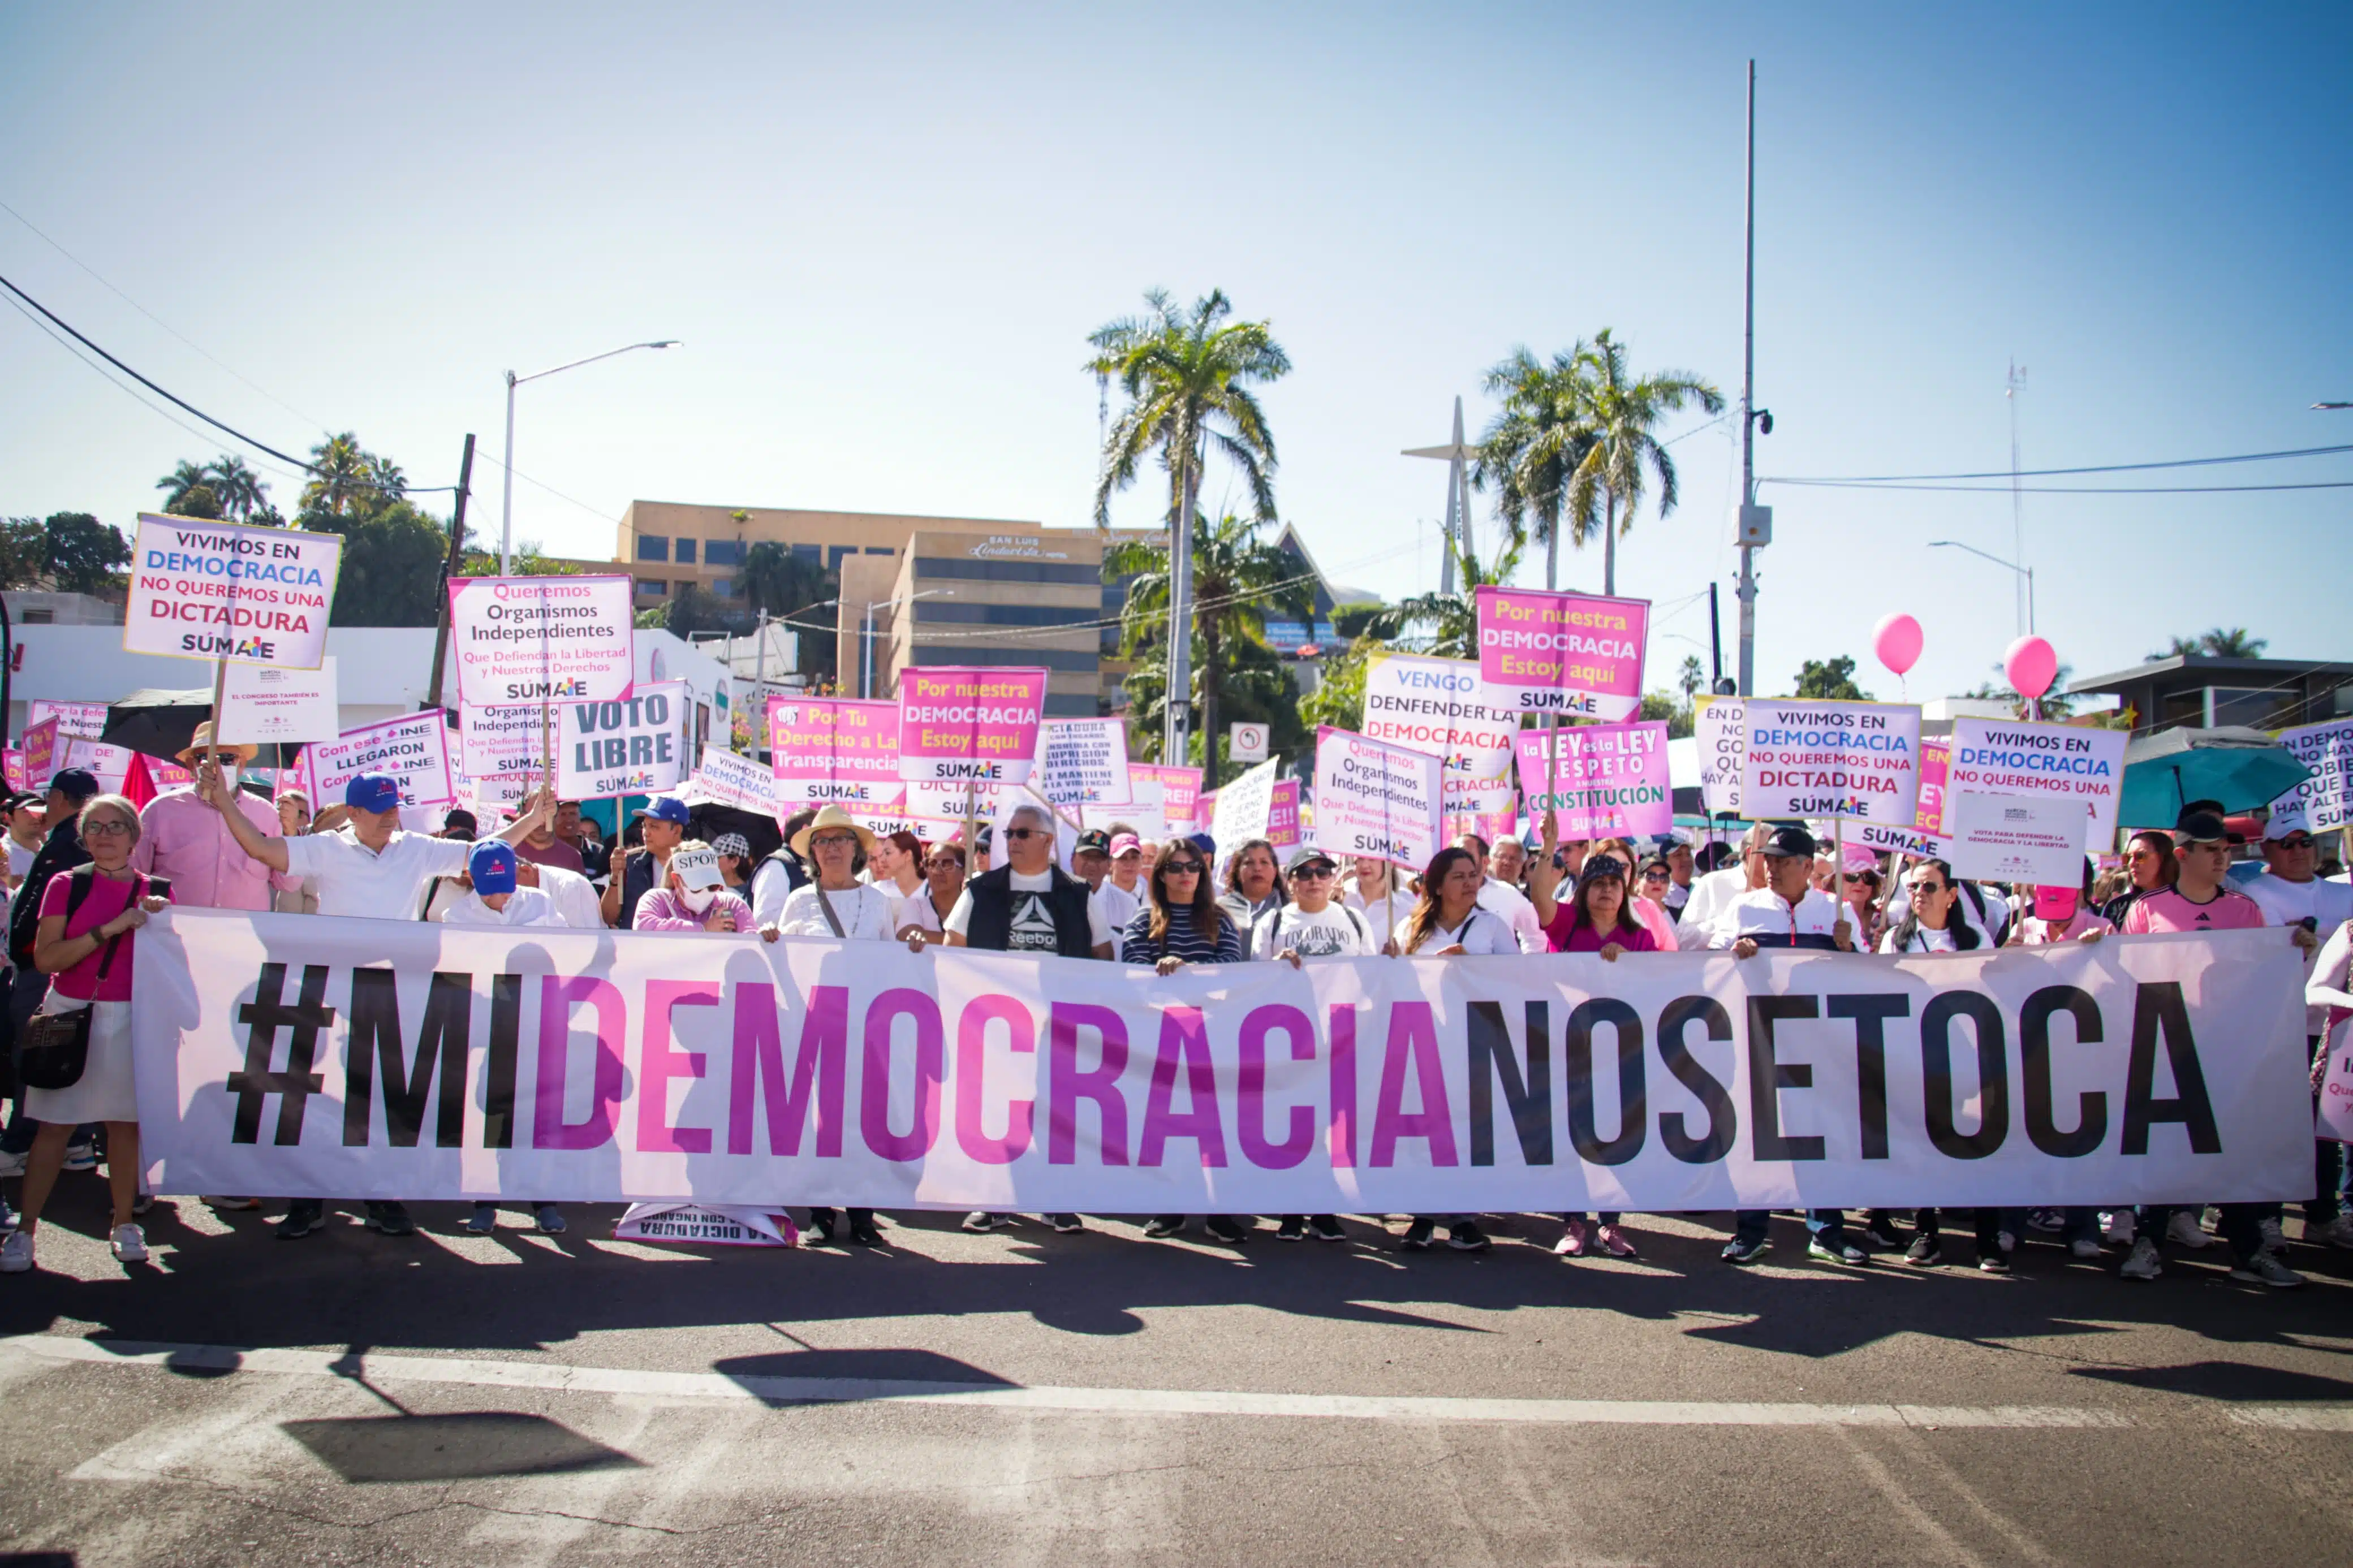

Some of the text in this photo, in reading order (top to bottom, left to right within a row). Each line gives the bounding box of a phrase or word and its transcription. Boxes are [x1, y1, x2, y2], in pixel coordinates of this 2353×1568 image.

[176, 532, 300, 560] VIVIMOS EN
[1015, 538, 1038, 546] LUIS
[147, 550, 323, 586] DEMOCRACIA
[141, 576, 325, 608] NO QUEREMOS UNA
[493, 584, 592, 601] Queremos
[150, 599, 309, 633] DICTADURA
[487, 604, 598, 622] Organismos
[1495, 600, 1627, 630] Por nuestra
[472, 623, 614, 643] Independientes
[1483, 629, 1636, 660] DEMOCRACIA
[463, 647, 626, 664] Que Defiendan la Libertad
[481, 662, 610, 679] y Nuestros Derechos
[1397, 669, 1474, 692] VENGO
[1501, 655, 1616, 686] Estoy aquí
[916, 680, 1029, 698] Por nuestra
[48, 705, 66, 714] Por
[70, 707, 78, 715] la
[575, 694, 669, 733] VOTO
[808, 707, 867, 727] Por Tu
[906, 707, 1037, 724] DEMOCRACIA
[1371, 695, 1515, 723] DENFENDER LA
[1706, 708, 1726, 720] EN
[1777, 712, 1886, 729] VIVIMOS EN
[71, 719, 106, 729] Nuest
[1368, 721, 1511, 750] DEMOCRACIA
[319, 744, 348, 758] Con
[354, 736, 381, 750] ese
[400, 724, 430, 736] INE
[467, 737, 535, 748] Que Defiendan
[777, 729, 898, 749] Derecho a La
[921, 729, 1020, 753] Estoy aquí
[1540, 733, 1583, 760] LEY
[1583, 741, 1597, 753] es
[1617, 729, 1657, 755] LEY
[1753, 729, 1908, 752] DEMOCRACIA
[1985, 731, 2091, 753] VIVIMOS EN
[337, 742, 424, 770] LLEGARON
[498, 756, 557, 770] SÚMAE
[575, 733, 673, 772] LIBRE
[775, 750, 898, 775] Transparencia
[1349, 740, 1415, 770] Queremos
[1749, 752, 1911, 771] NO QUEREMOS UNA
[1960, 748, 2110, 777] DEMOCRACIA
[2294, 750, 2319, 762] NO
[322, 757, 435, 788] Con INE
[719, 756, 772, 784] VIVIMOS EN
[1343, 758, 1418, 790] Organismos
[1701, 772, 1725, 785] HAY
[1759, 770, 1898, 794] DICTADURA
[701, 777, 713, 789] NO
[715, 782, 759, 806] QUEREMOS
[760, 800, 778, 813] UNA
[1331, 774, 1428, 811] Independientes
[1444, 780, 1507, 793] CRACIA
[1954, 770, 2111, 796] NO QUEREMOS UNA
[2296, 776, 2340, 798] QUE
[1529, 779, 1665, 812] CONSTITUCIÓN
[2274, 800, 2308, 814] HAY
[1321, 798, 1343, 809] Que
[1347, 801, 1392, 819] Defiendan
[1402, 816, 1435, 832] Libertad
[1335, 815, 1340, 825] y
[1344, 814, 1387, 831] Nuestros
[1389, 823, 1424, 841] Derechos
[1283, 924, 1351, 948] COLORADO
[226, 961, 2222, 1170] #MIDEMOCRACIANOSETOCA
[640, 1221, 741, 1239] DICTADURA
[701, 1213, 725, 1224] CON
